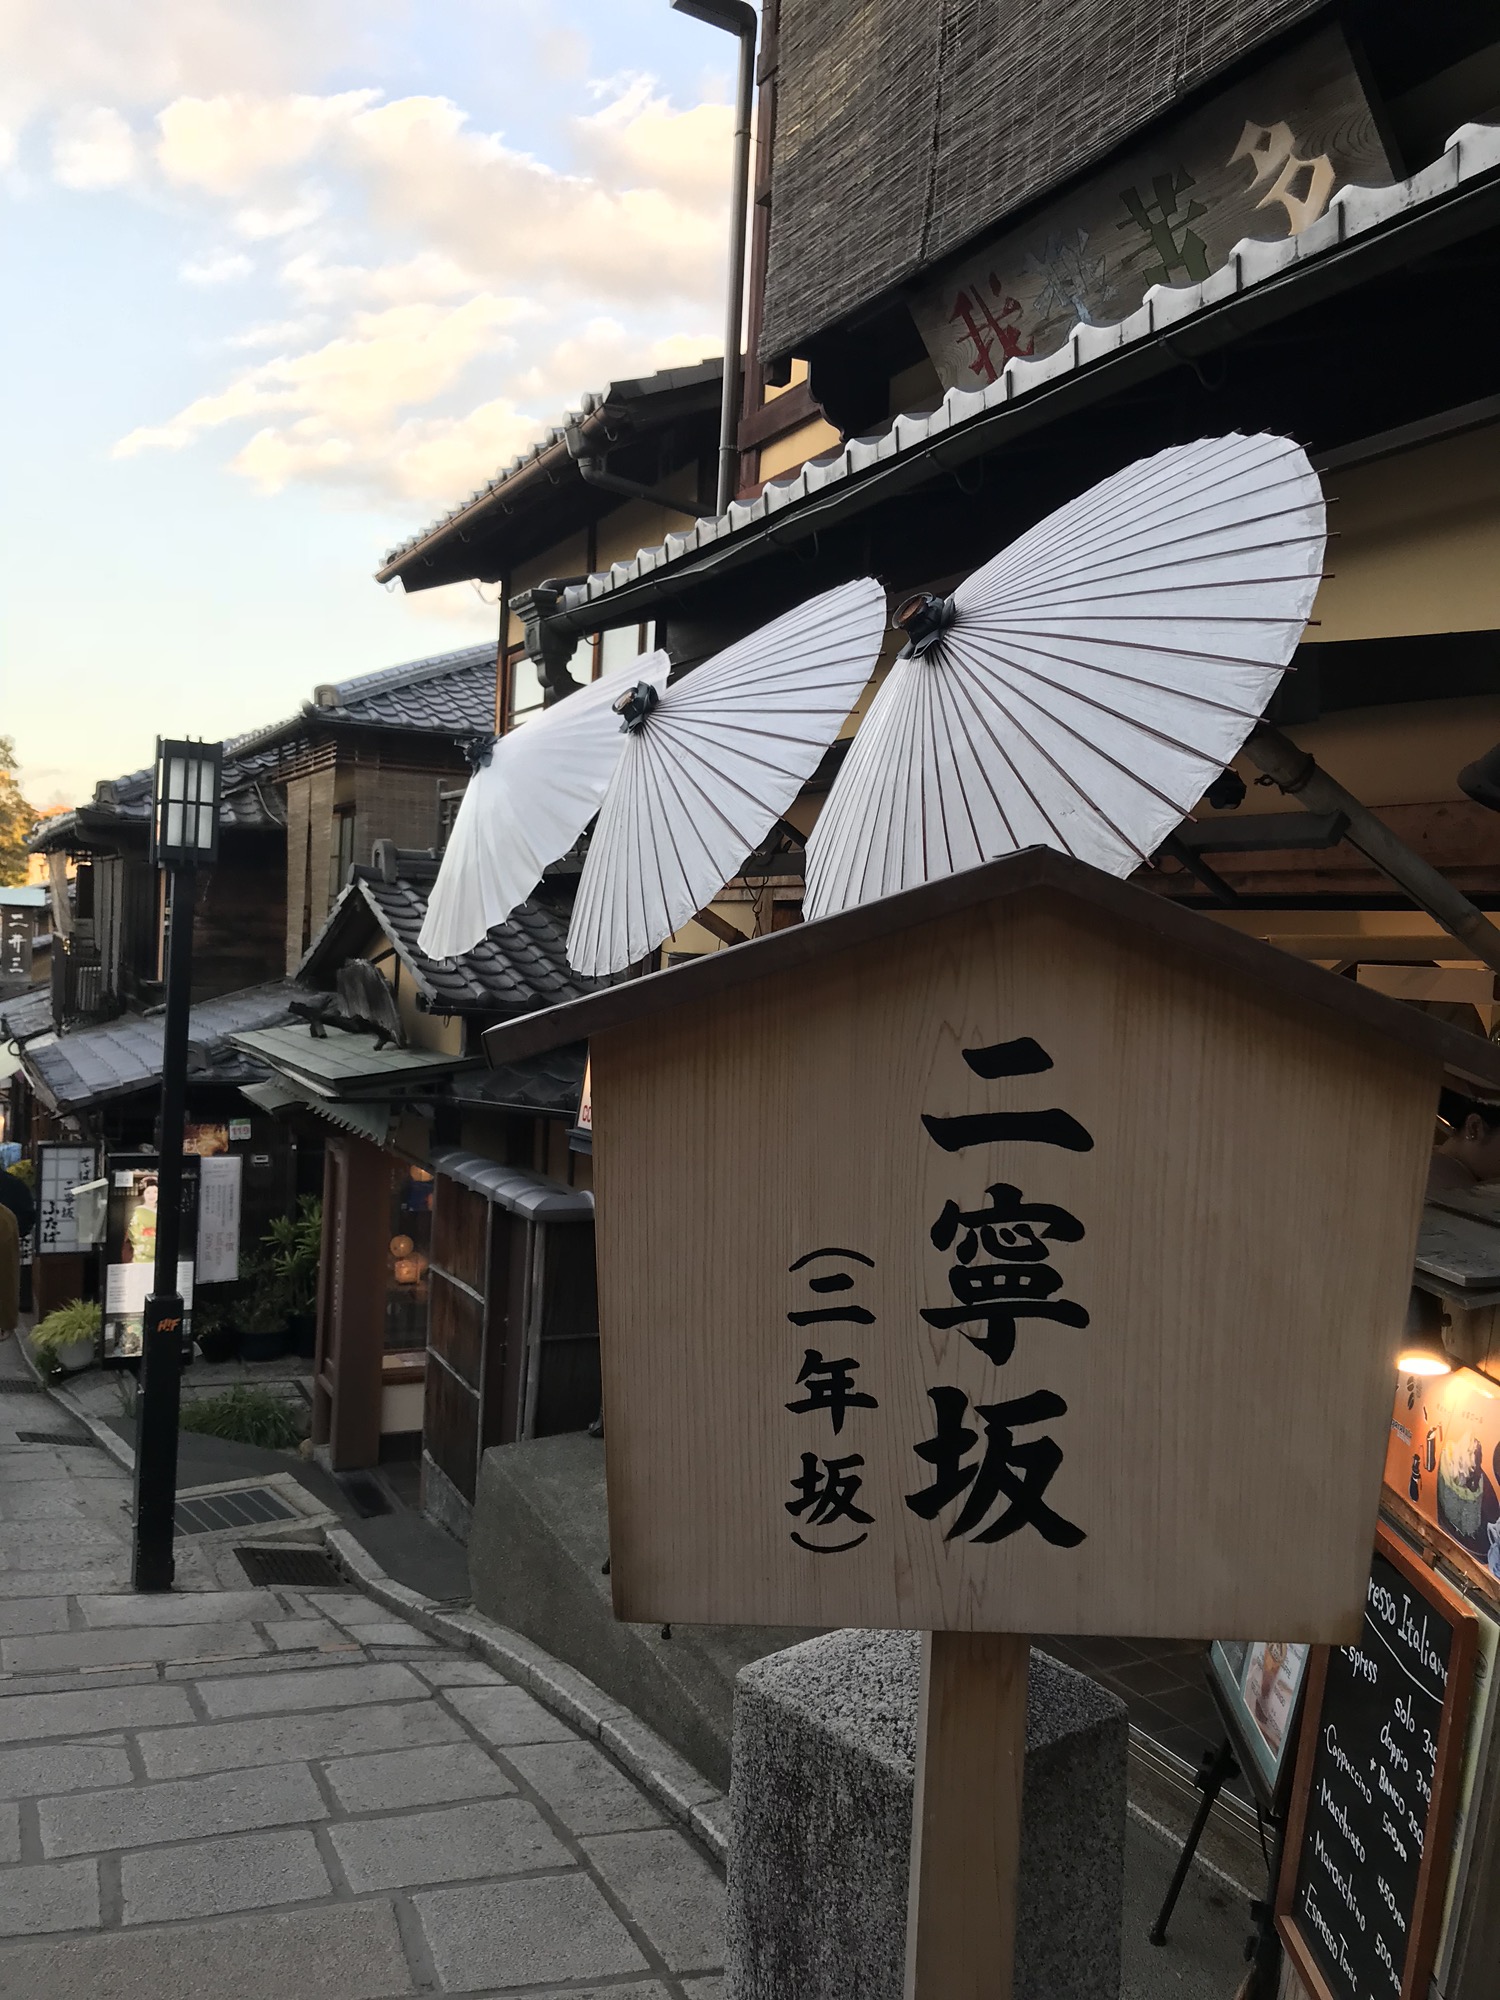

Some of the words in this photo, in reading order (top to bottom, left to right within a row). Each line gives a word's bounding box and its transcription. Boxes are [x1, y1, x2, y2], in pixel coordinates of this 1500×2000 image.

[43, 1201, 60, 1243] ふたば
[905, 1037, 1094, 1548] 二寧坂
[784, 1248, 878, 1553] (二年坂)
[1368, 1577, 1396, 1625] resso
[1381, 1721, 1408, 1772] doppio
[1394, 1694, 1415, 1732] solo
[1326, 1724, 1372, 1804] Cappuccino
[1379, 1766, 1405, 1815] BANCO
[1321, 1778, 1366, 1863] Macchiato
[1315, 1830, 1366, 1931] Marocchino
[1305, 1882, 1338, 1960] Espresso
[1339, 1933, 1358, 1992] Tonic
